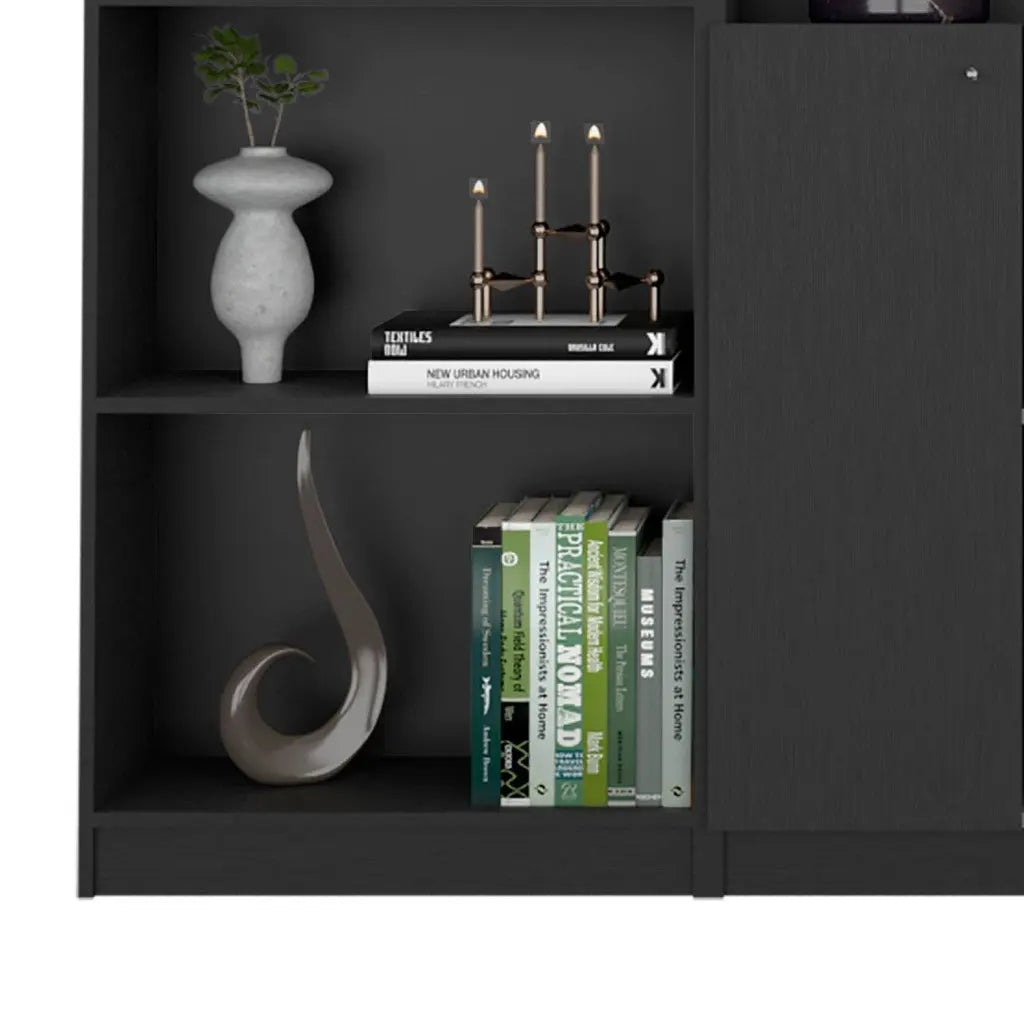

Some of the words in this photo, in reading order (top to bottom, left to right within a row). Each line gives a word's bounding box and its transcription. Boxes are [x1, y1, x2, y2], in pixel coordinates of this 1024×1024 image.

[384, 331, 433, 344] TEXTILES
[427, 369, 451, 380] NEW
[454, 369, 490, 380] URBAN
[492, 369, 541, 380] HOUSING
[427, 380, 454, 389] HILARY
[455, 380, 488, 389] FRENCH
[587, 540, 604, 570] Ancient
[538, 561, 549, 584] The
[674, 559, 686, 583] The
[557, 532, 582, 640] PRACTICAL
[587, 571, 604, 601] Wisdom
[511, 590, 525, 629] Quantum
[587, 602, 604, 613] for
[513, 631, 525, 651] Field
[536, 588, 549, 681] Impressionists
[587, 615, 604, 645] Modern
[640, 588, 654, 679] MUSEUMS
[671, 586, 686, 681] Impressionists
[587, 646, 604, 673] Health
[615, 644, 627, 660] The
[510, 653, 525, 681] Theory
[538, 685, 549, 700] at
[557, 644, 582, 747] NOMAD
[674, 686, 686, 700] at
[538, 703, 549, 740] Home
[674, 704, 686, 741] Home
